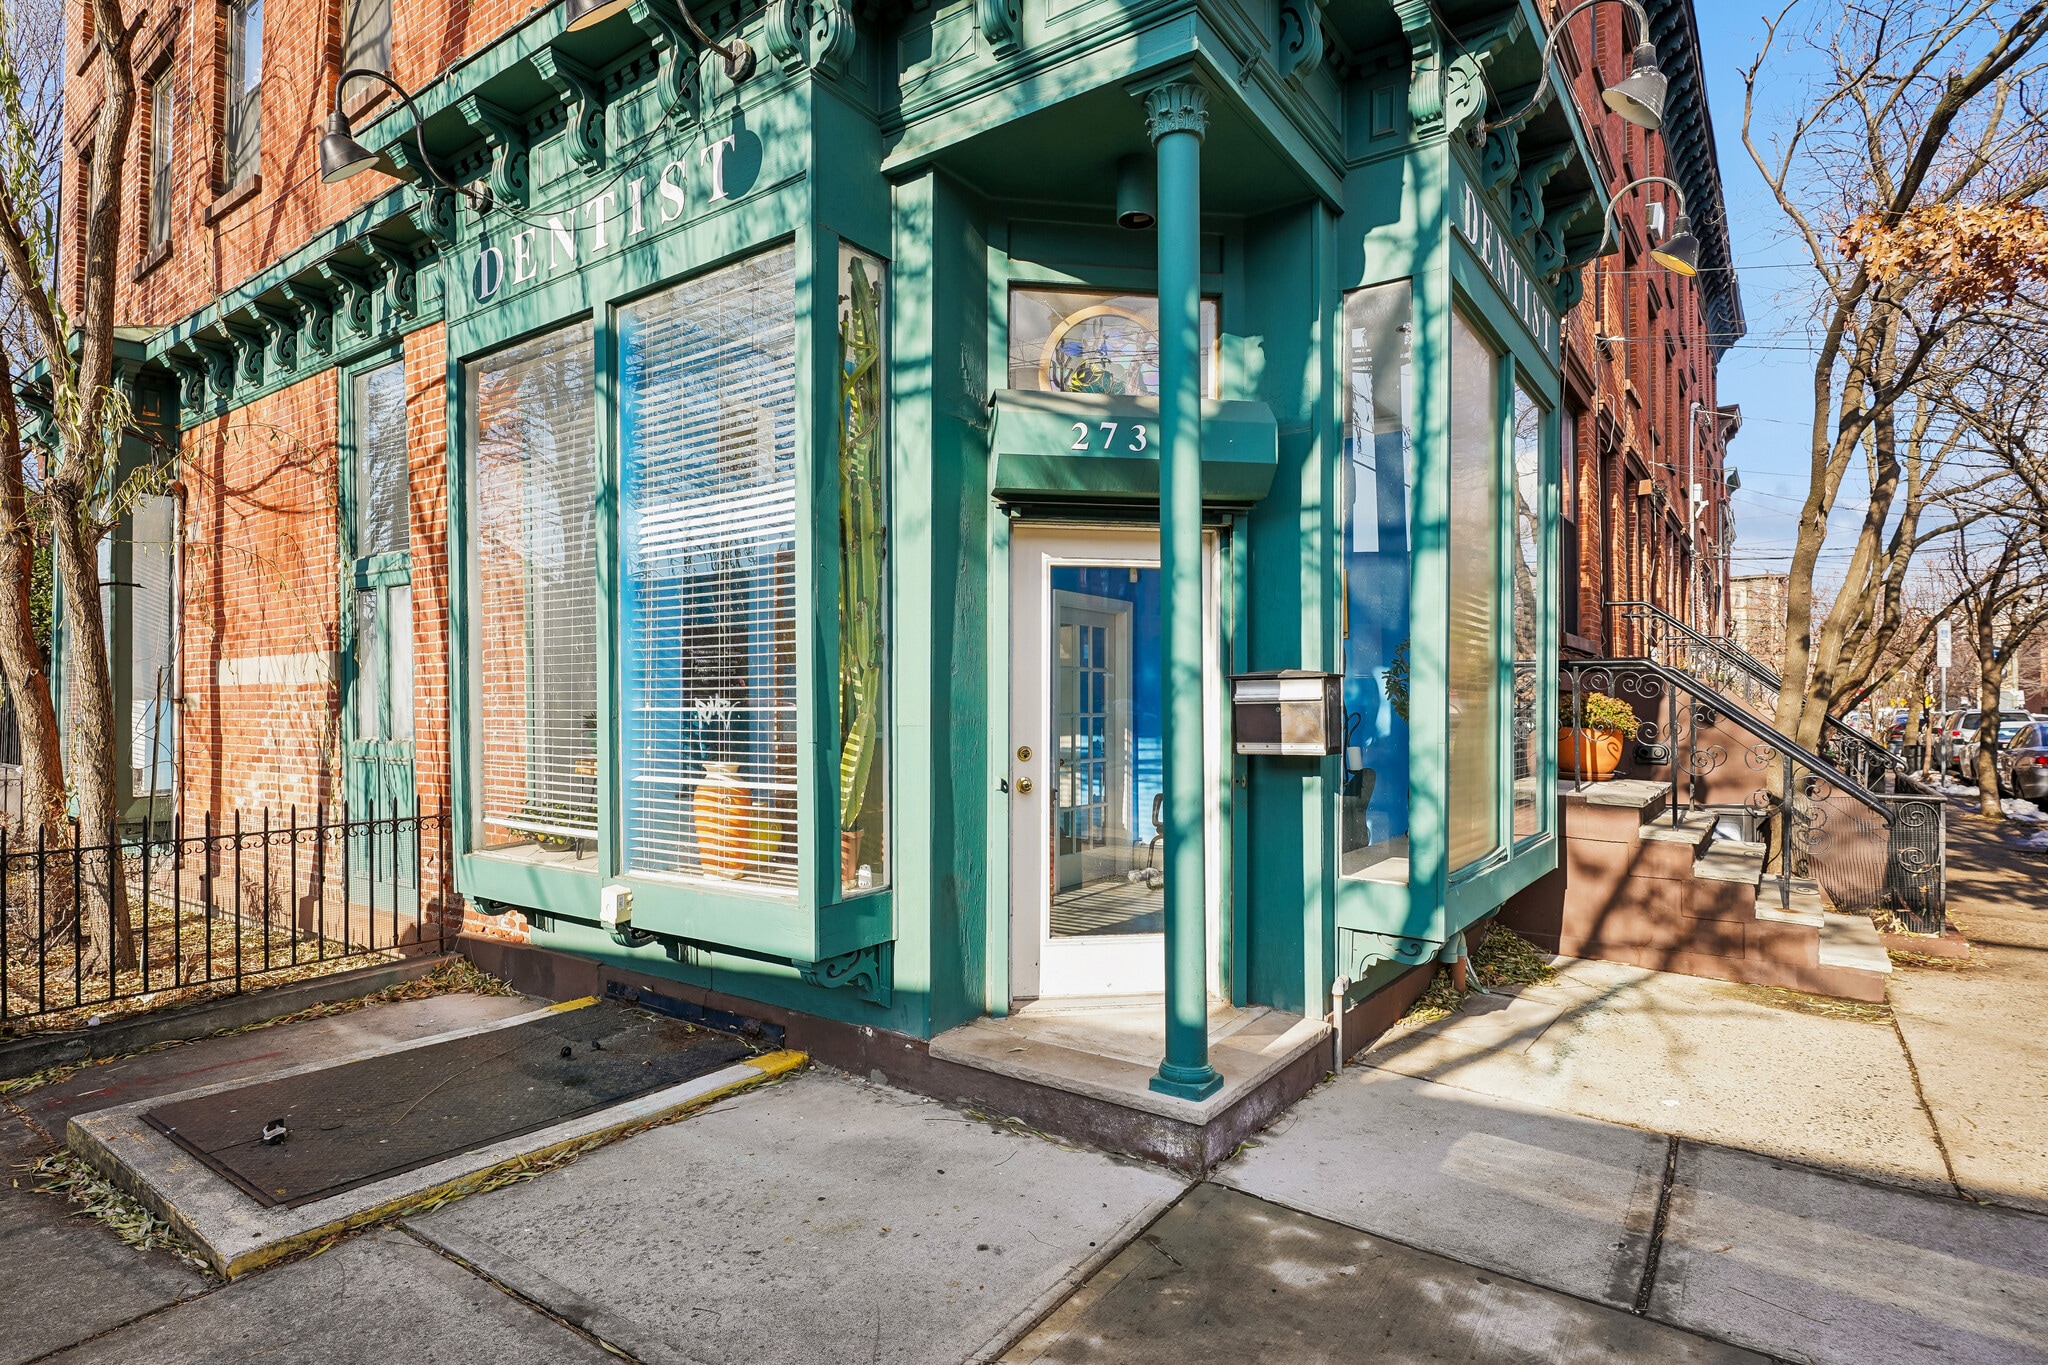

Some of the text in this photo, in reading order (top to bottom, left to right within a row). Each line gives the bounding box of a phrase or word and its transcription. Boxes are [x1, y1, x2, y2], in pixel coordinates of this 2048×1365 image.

[477, 133, 736, 300] DENTIST
[1463, 181, 1551, 353] DENTIST
[1070, 421, 1148, 452] 273
